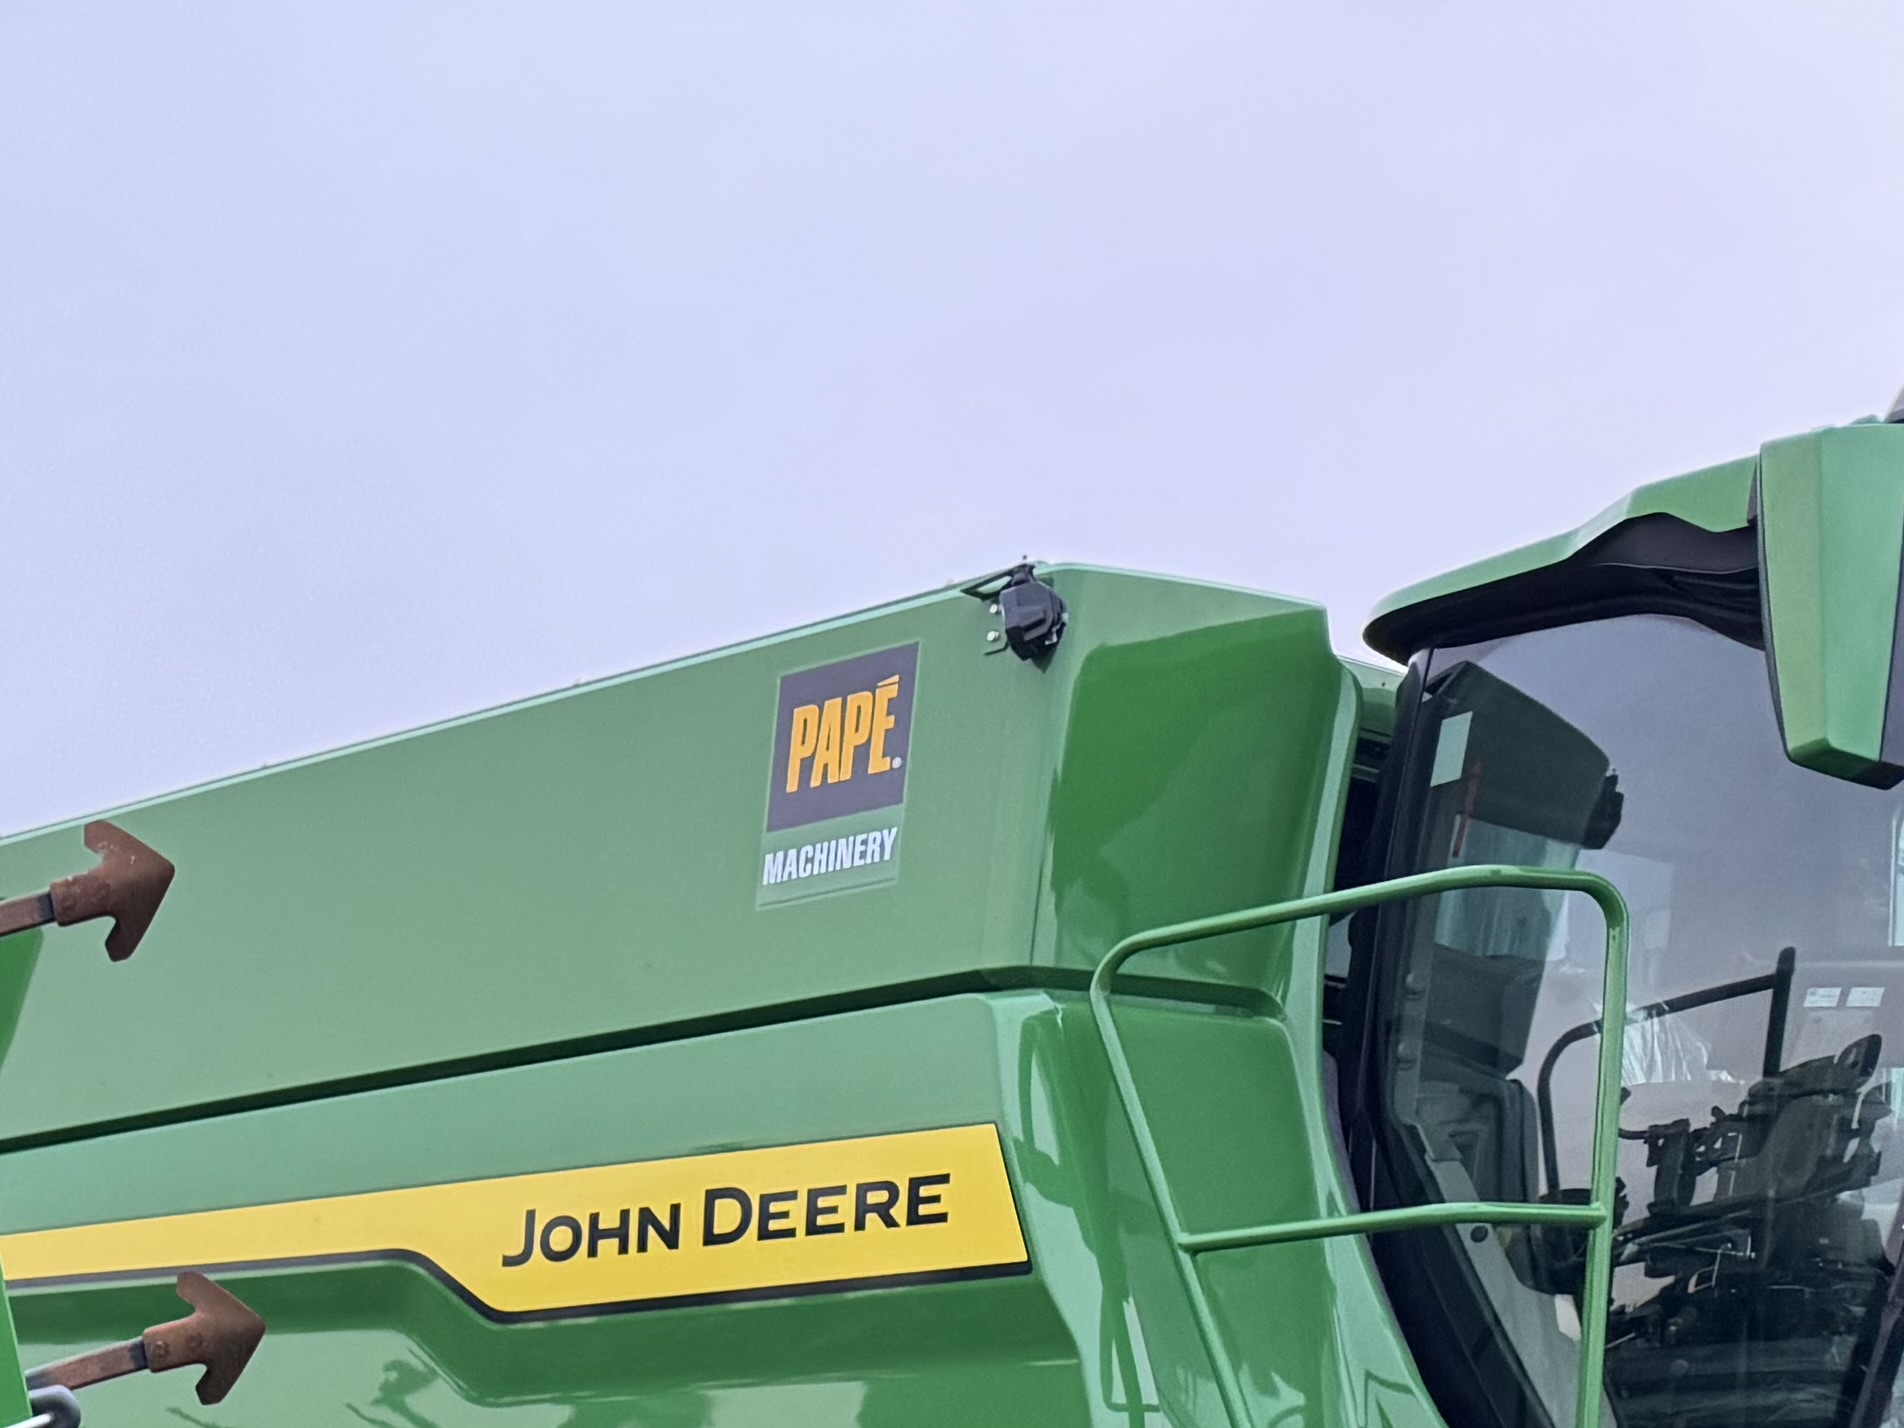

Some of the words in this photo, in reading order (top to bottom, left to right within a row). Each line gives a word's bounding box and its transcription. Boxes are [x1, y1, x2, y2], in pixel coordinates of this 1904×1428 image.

[786, 675, 900, 793] PAPÉ
[762, 826, 898, 885] MACHINERY
[501, 1203, 682, 1267] JOHN
[702, 1173, 951, 1246] DEERE
